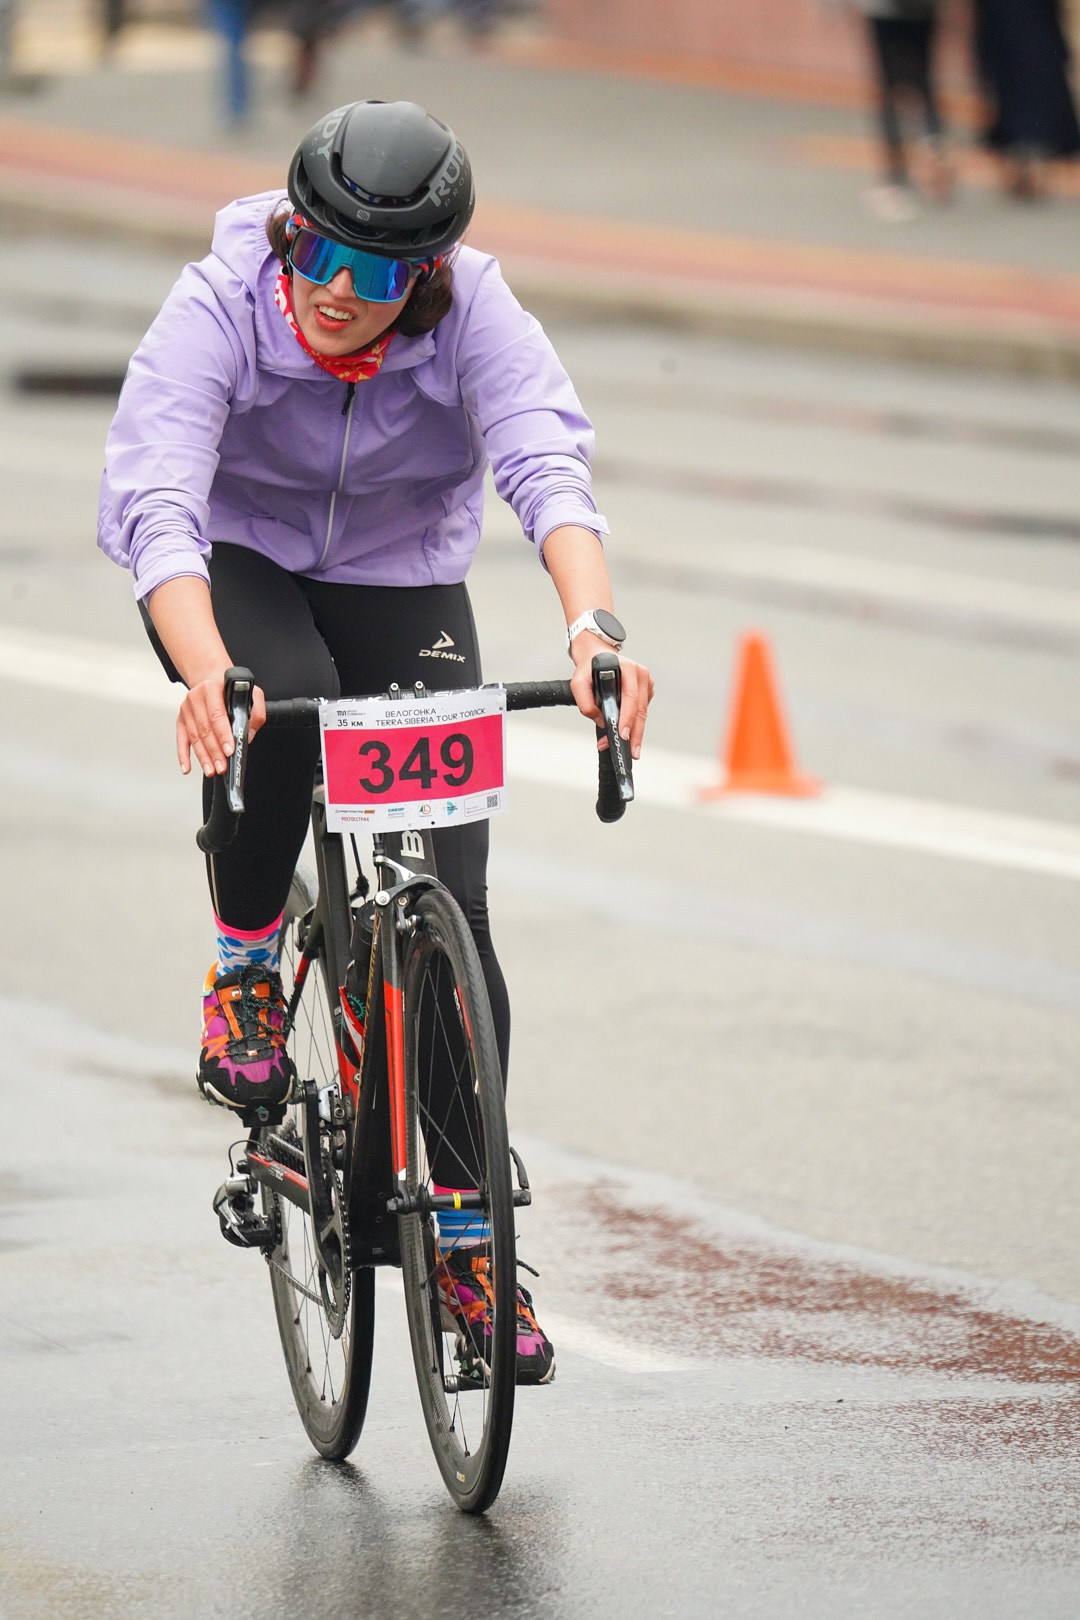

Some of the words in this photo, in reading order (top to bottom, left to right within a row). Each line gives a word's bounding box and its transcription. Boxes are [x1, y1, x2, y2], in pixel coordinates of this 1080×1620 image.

[418, 649, 466, 664] DEMIX
[376, 719, 403, 727] TERRA
[404, 717, 434, 725] SIBERIA
[436, 713, 458, 721] TOUR
[385, 708, 437, 718] ВЕЛОГОНКА
[337, 719, 348, 727] 35
[358, 733, 474, 794] 349
